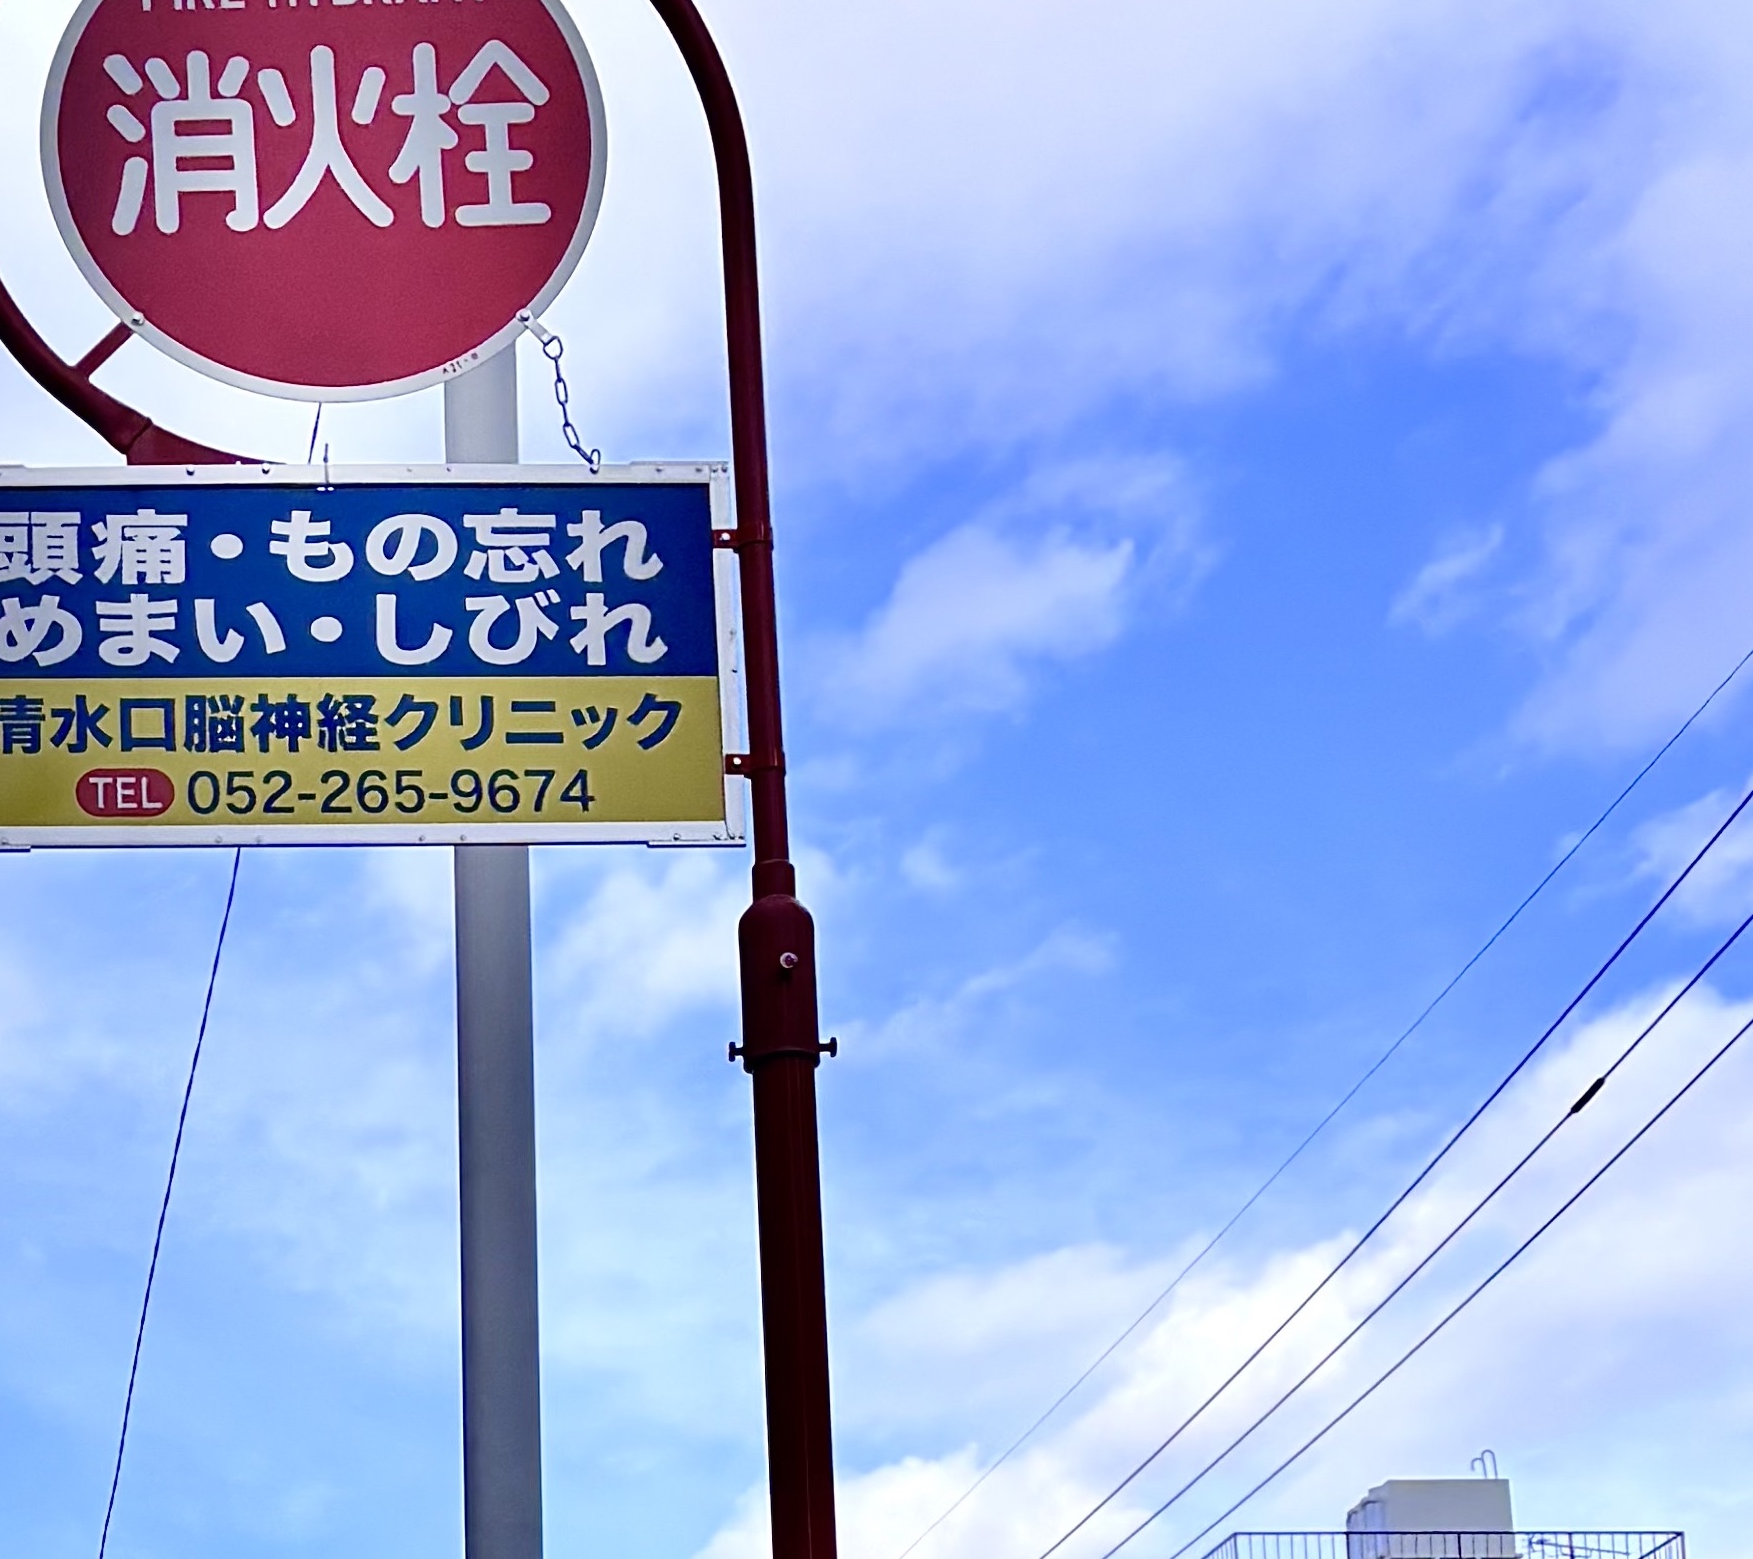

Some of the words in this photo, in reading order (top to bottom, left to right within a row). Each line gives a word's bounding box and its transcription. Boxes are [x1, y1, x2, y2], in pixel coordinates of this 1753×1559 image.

[103, 40, 551, 235] 消火栓
[88, 776, 162, 811] TEL
[187, 769, 596, 815] 052-265-9674
